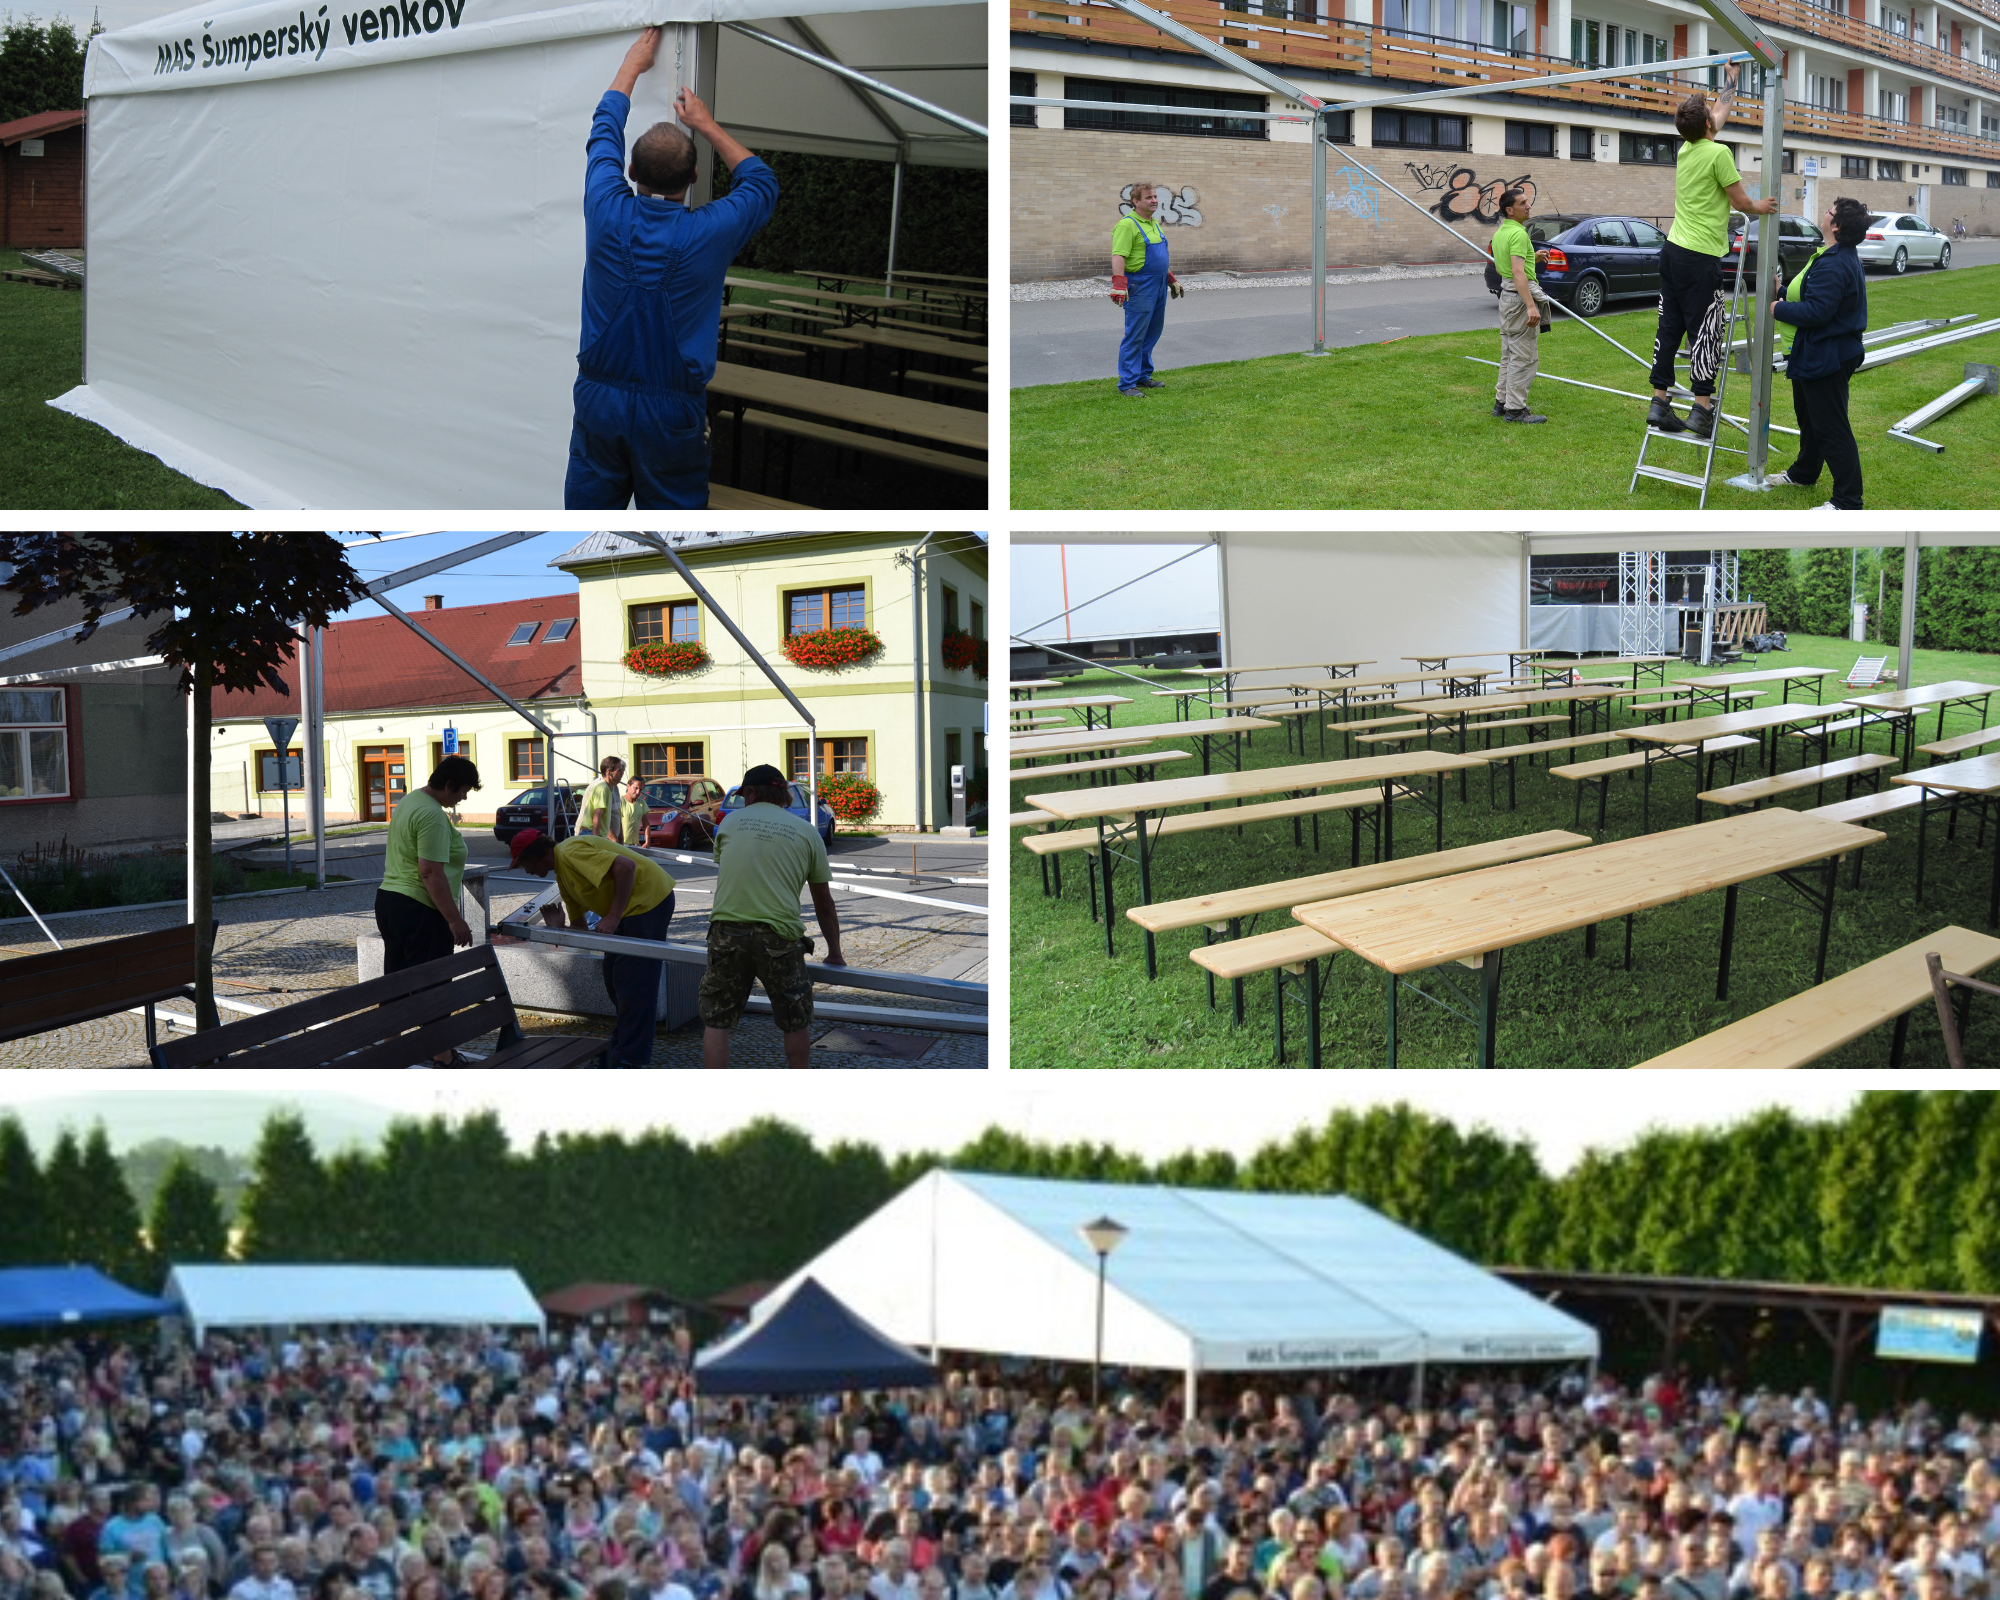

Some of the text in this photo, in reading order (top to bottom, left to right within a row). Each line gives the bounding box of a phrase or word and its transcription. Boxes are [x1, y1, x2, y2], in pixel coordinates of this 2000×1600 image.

[154, 0, 466, 75] MAS Šumperský venkov
[446, 731, 454, 746] P
